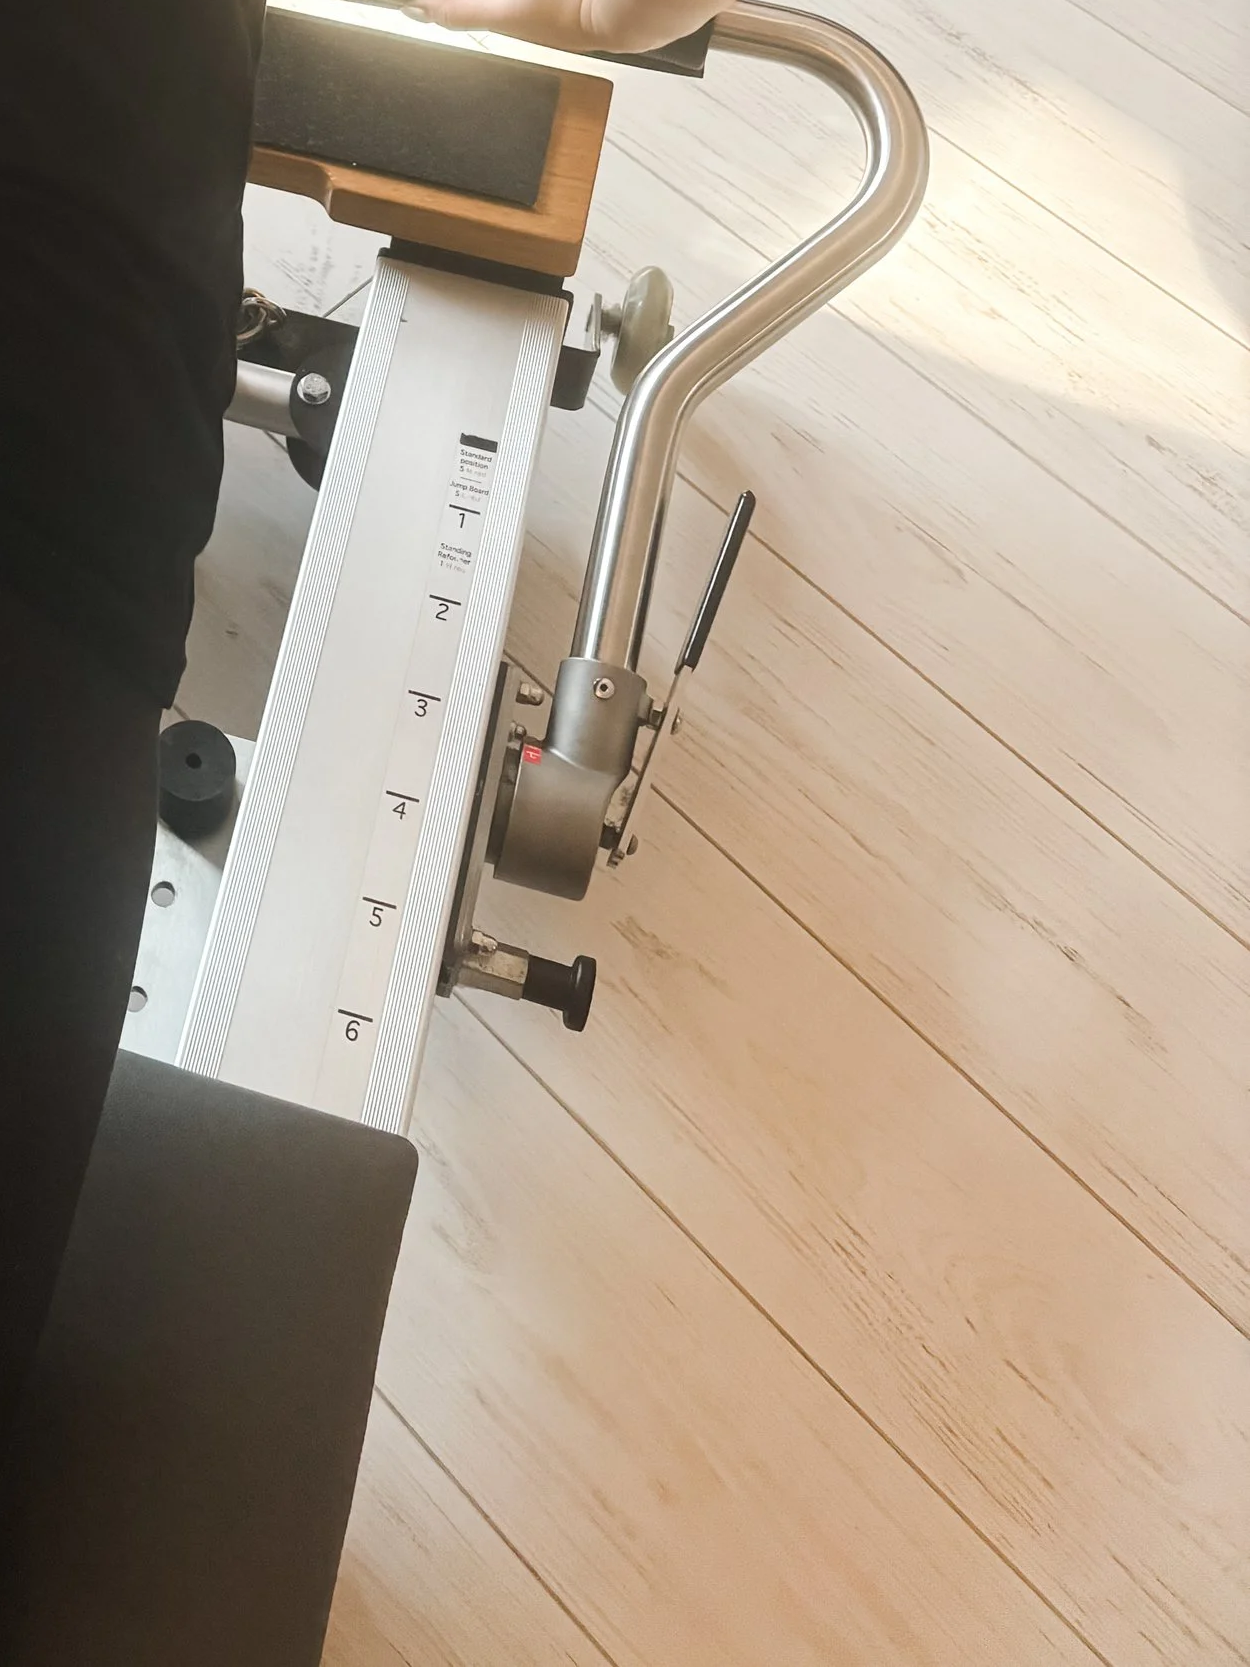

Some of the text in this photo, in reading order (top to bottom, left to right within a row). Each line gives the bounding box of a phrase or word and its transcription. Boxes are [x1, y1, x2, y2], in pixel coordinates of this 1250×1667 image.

[459, 448, 493, 463] Standard
[460, 457, 489, 470] position
[449, 480, 490, 496] Jump Board
[459, 512, 465, 529] 1
[440, 542, 472, 558] Standing
[435, 603, 449, 621] 2
[414, 698, 429, 718] 3
[391, 801, 407, 820] 4
[369, 907, 383, 928] 5
[345, 1021, 359, 1042] 6
